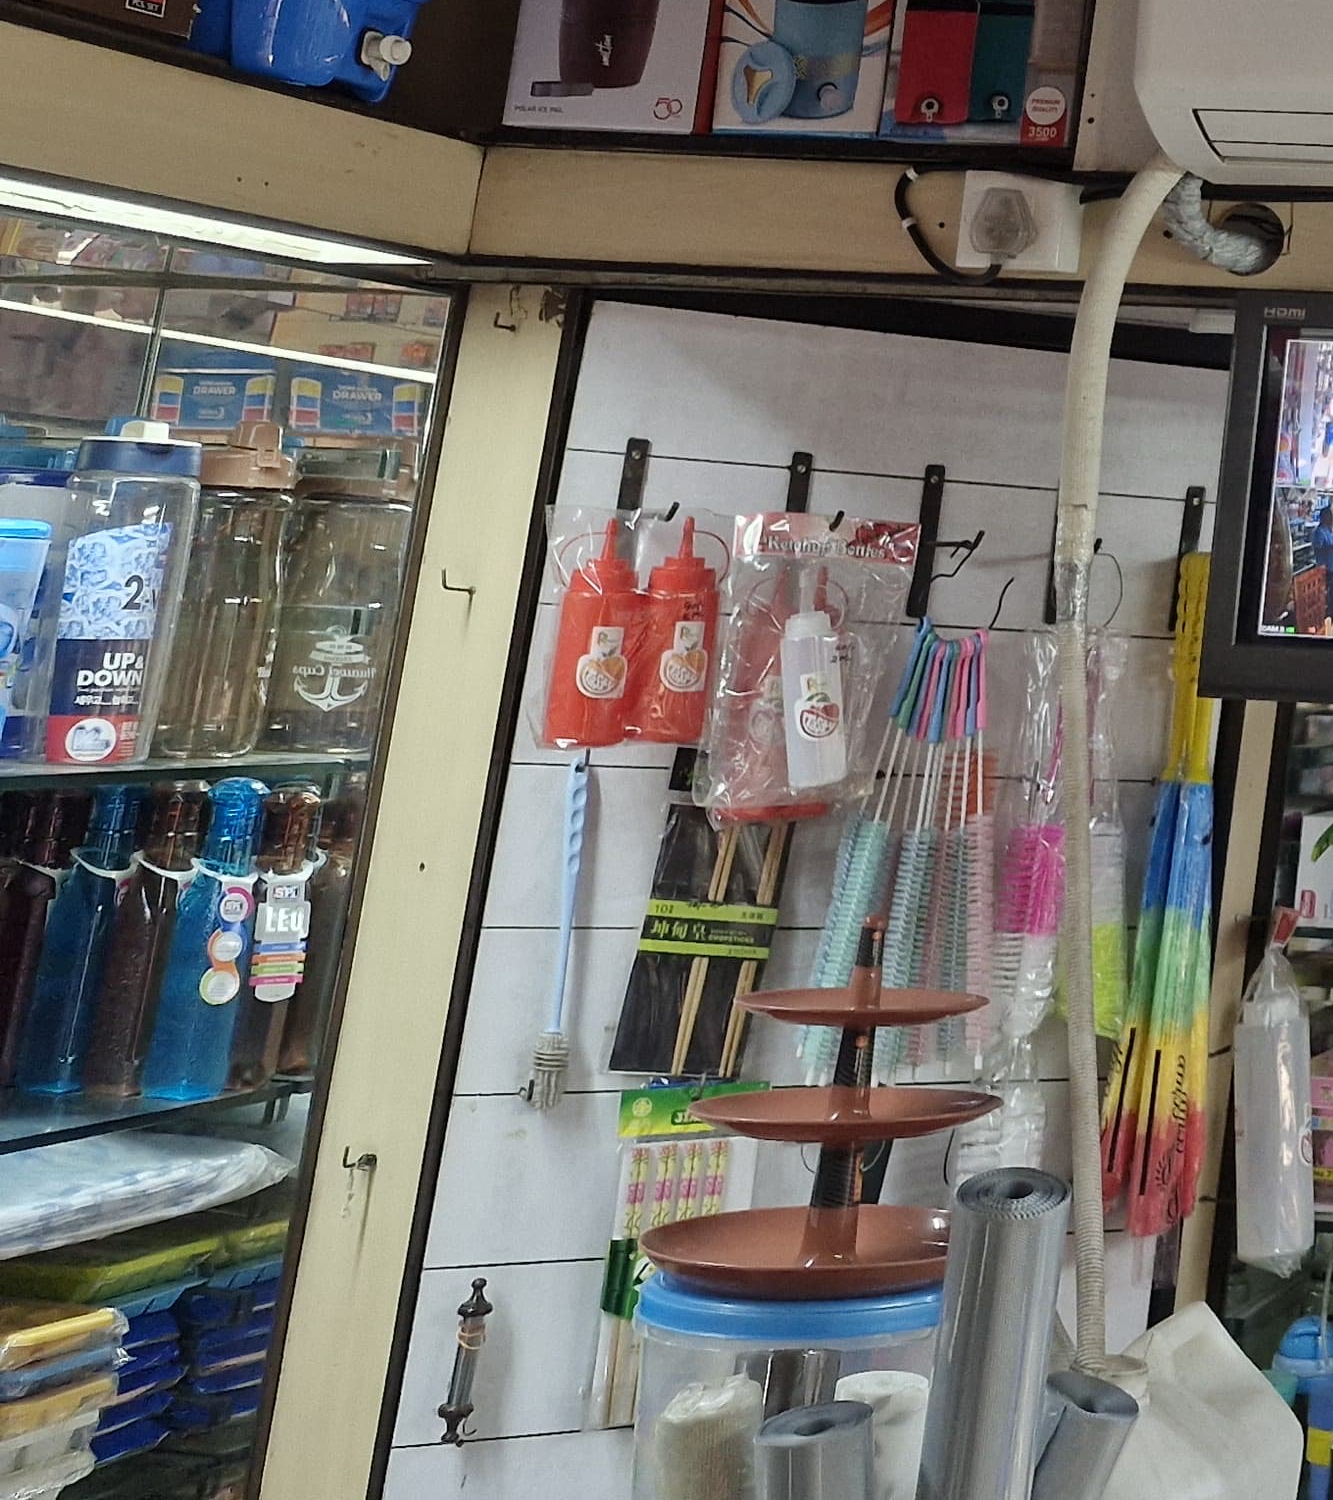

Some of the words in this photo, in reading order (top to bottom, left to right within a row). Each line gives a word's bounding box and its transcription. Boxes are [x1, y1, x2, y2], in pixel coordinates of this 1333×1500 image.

[1029, 127, 1057, 138] 3500
[193, 386, 235, 395] DRAWER
[332, 391, 382, 401] DRAWER
[76, 670, 142, 687] DOWN
[265, 906, 304, 933] LEO
